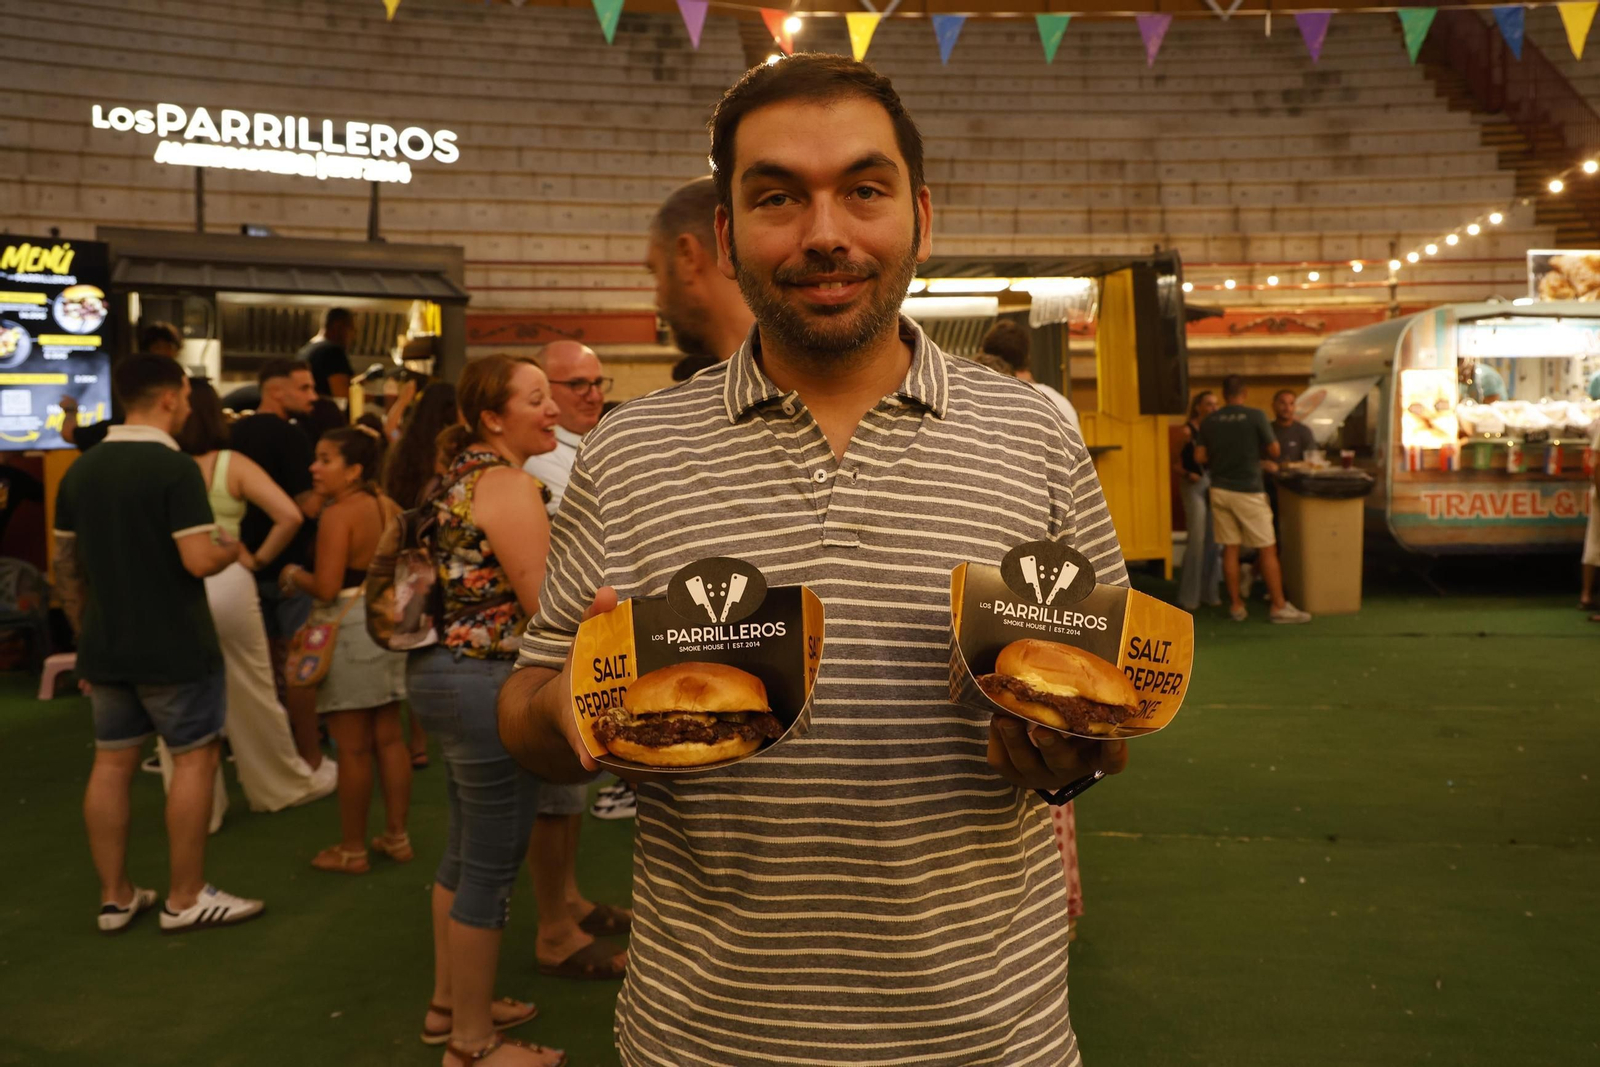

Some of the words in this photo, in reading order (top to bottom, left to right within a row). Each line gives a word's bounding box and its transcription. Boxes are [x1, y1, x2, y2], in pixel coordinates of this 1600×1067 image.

[92, 104, 156, 134] LOS
[157, 103, 461, 163] PARRILLEROS
[1422, 490, 1548, 518] TRAVEL
[1553, 490, 1577, 518] &
[994, 600, 1107, 631] PARRILLEROS
[1003, 619, 1024, 628] SMOKE
[1026, 622, 1046, 631] HOUSE
[1066, 628, 1081, 636] 2014
[666, 621, 787, 644] PARRILLEROS
[679, 645, 701, 653] SMOKE
[703, 643, 724, 651] HOUSE
[1127, 636, 1172, 665] SALT.
[592, 654, 631, 683] SALT.
